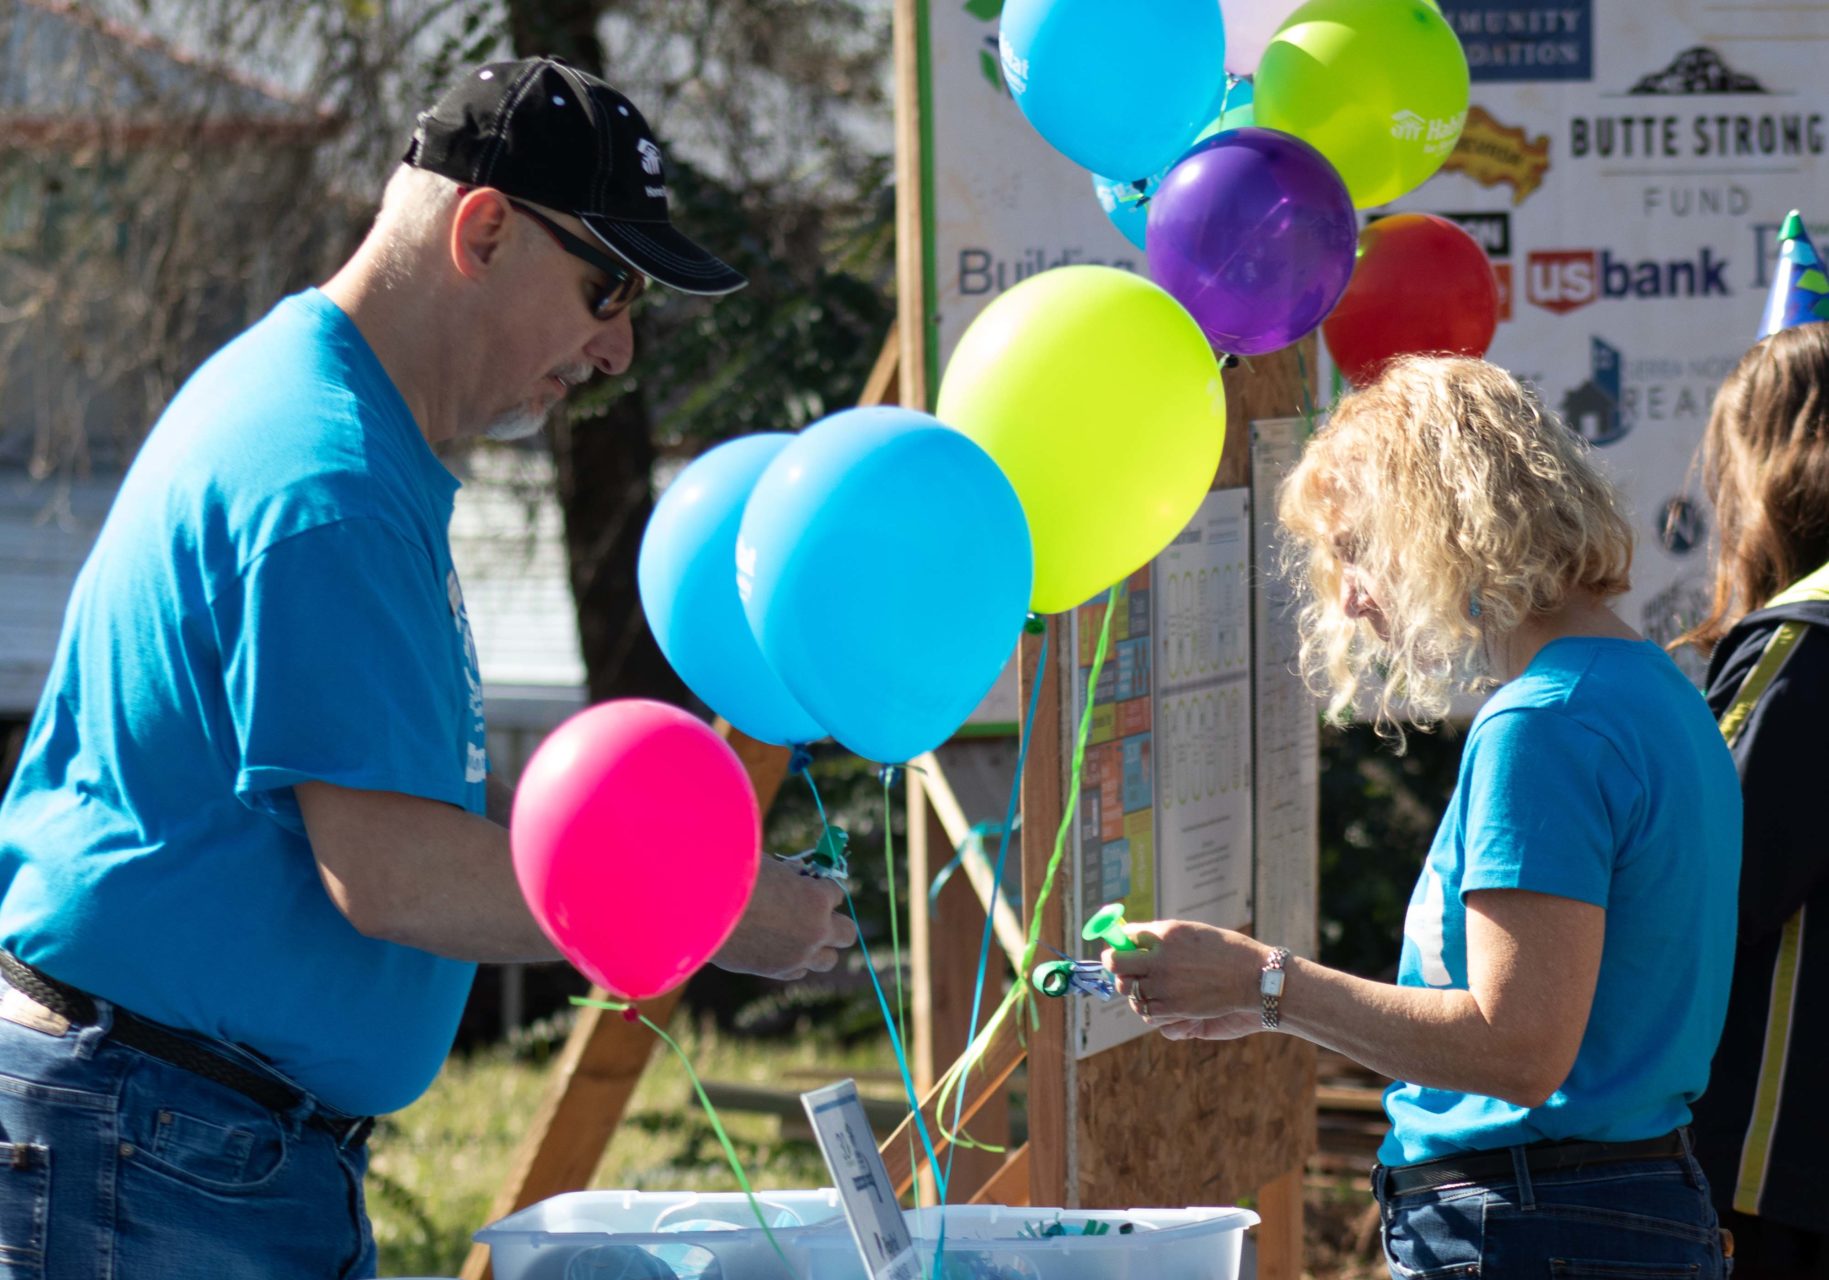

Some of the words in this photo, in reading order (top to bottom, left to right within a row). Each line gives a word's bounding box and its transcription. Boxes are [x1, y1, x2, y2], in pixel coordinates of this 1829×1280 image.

[1570, 116, 1679, 158] BUTTE
[1693, 113, 1825, 157] STRONG
[1643, 185, 1752, 216] FUND
